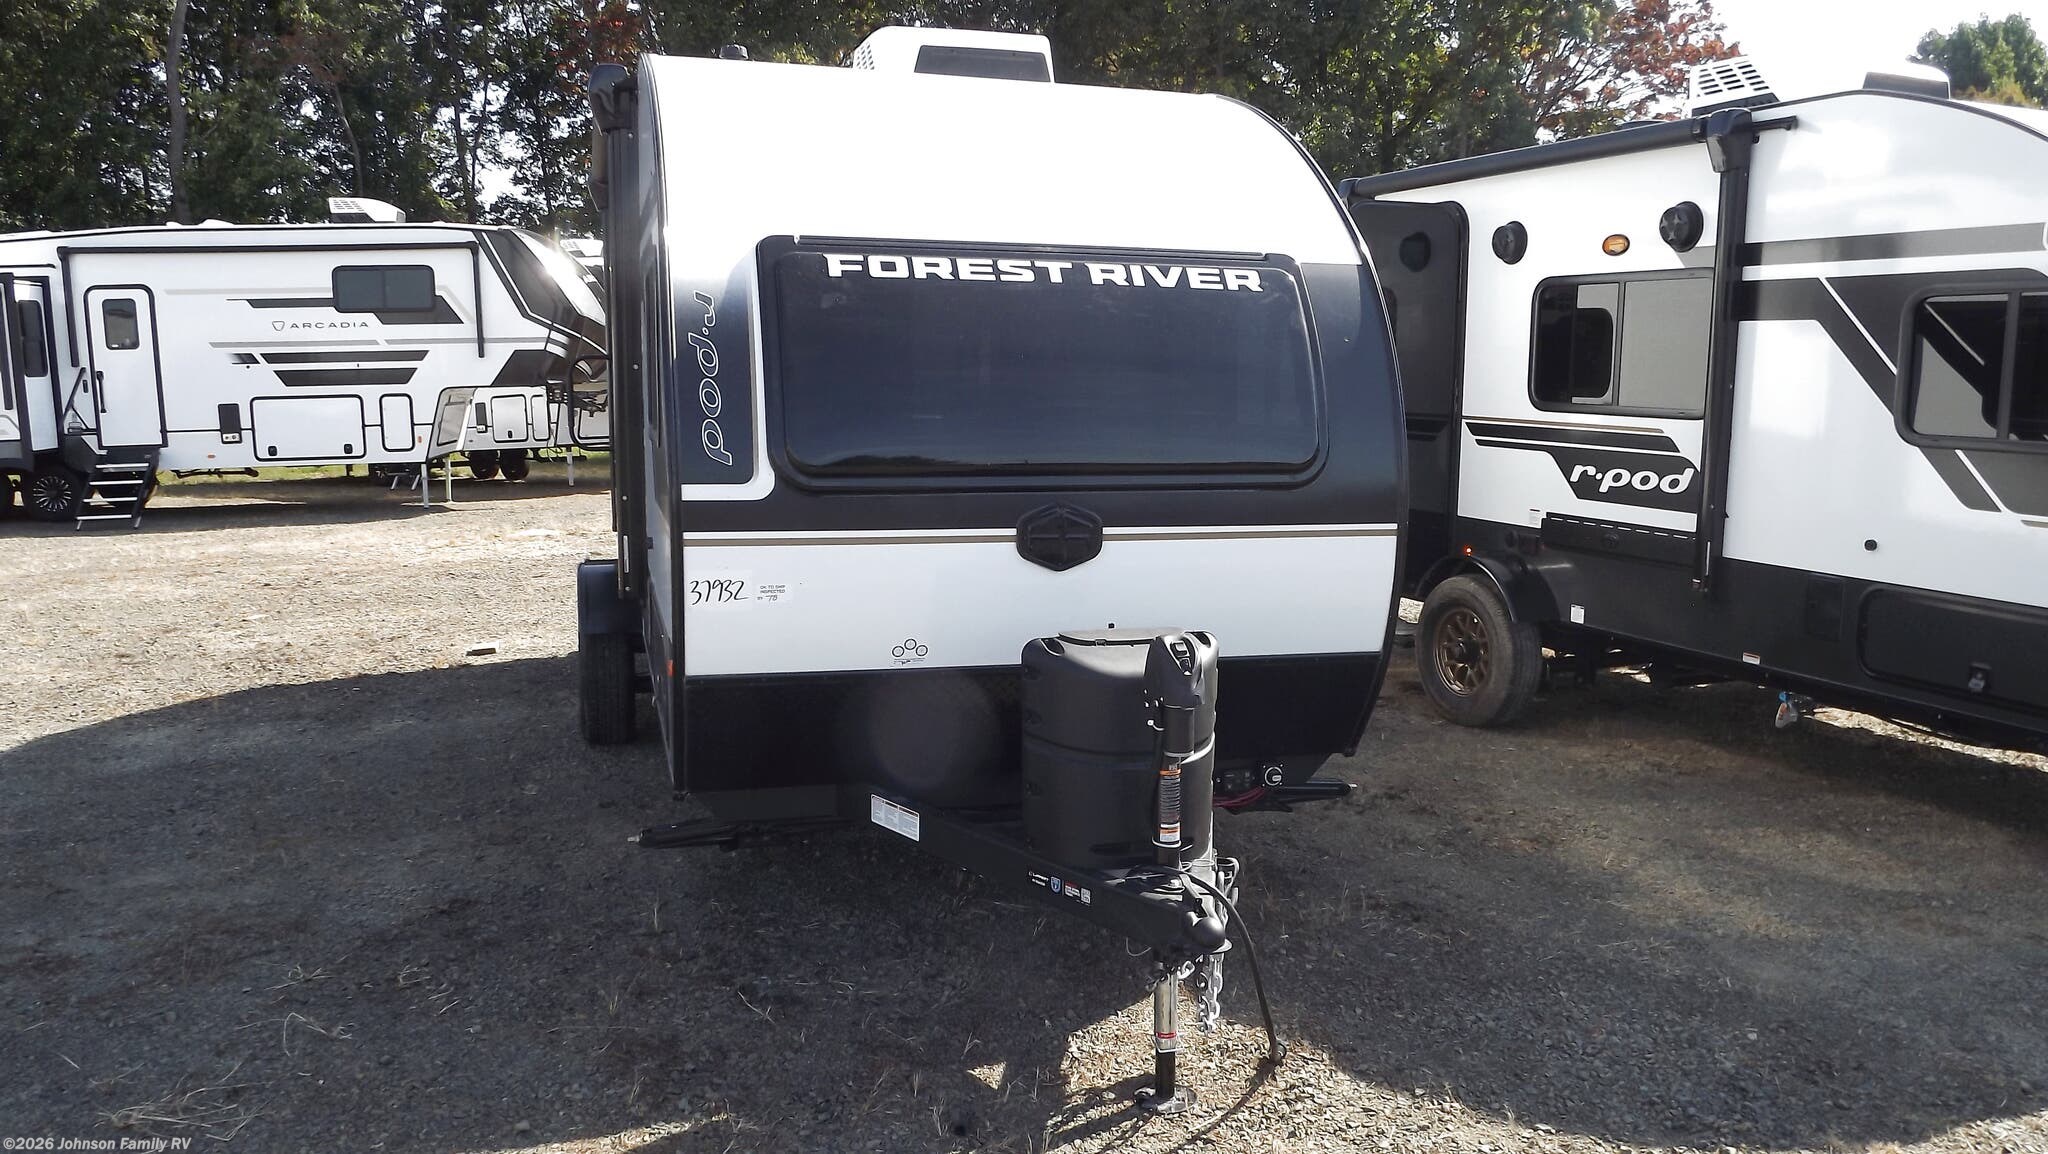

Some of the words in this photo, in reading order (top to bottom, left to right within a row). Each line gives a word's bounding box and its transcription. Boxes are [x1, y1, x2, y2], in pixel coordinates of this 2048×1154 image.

[823, 253, 1073, 284] FOREST
[1084, 262, 1264, 292] RIVER
[290, 321, 369, 329] ARCADIA
[689, 579, 750, 605] 37932
